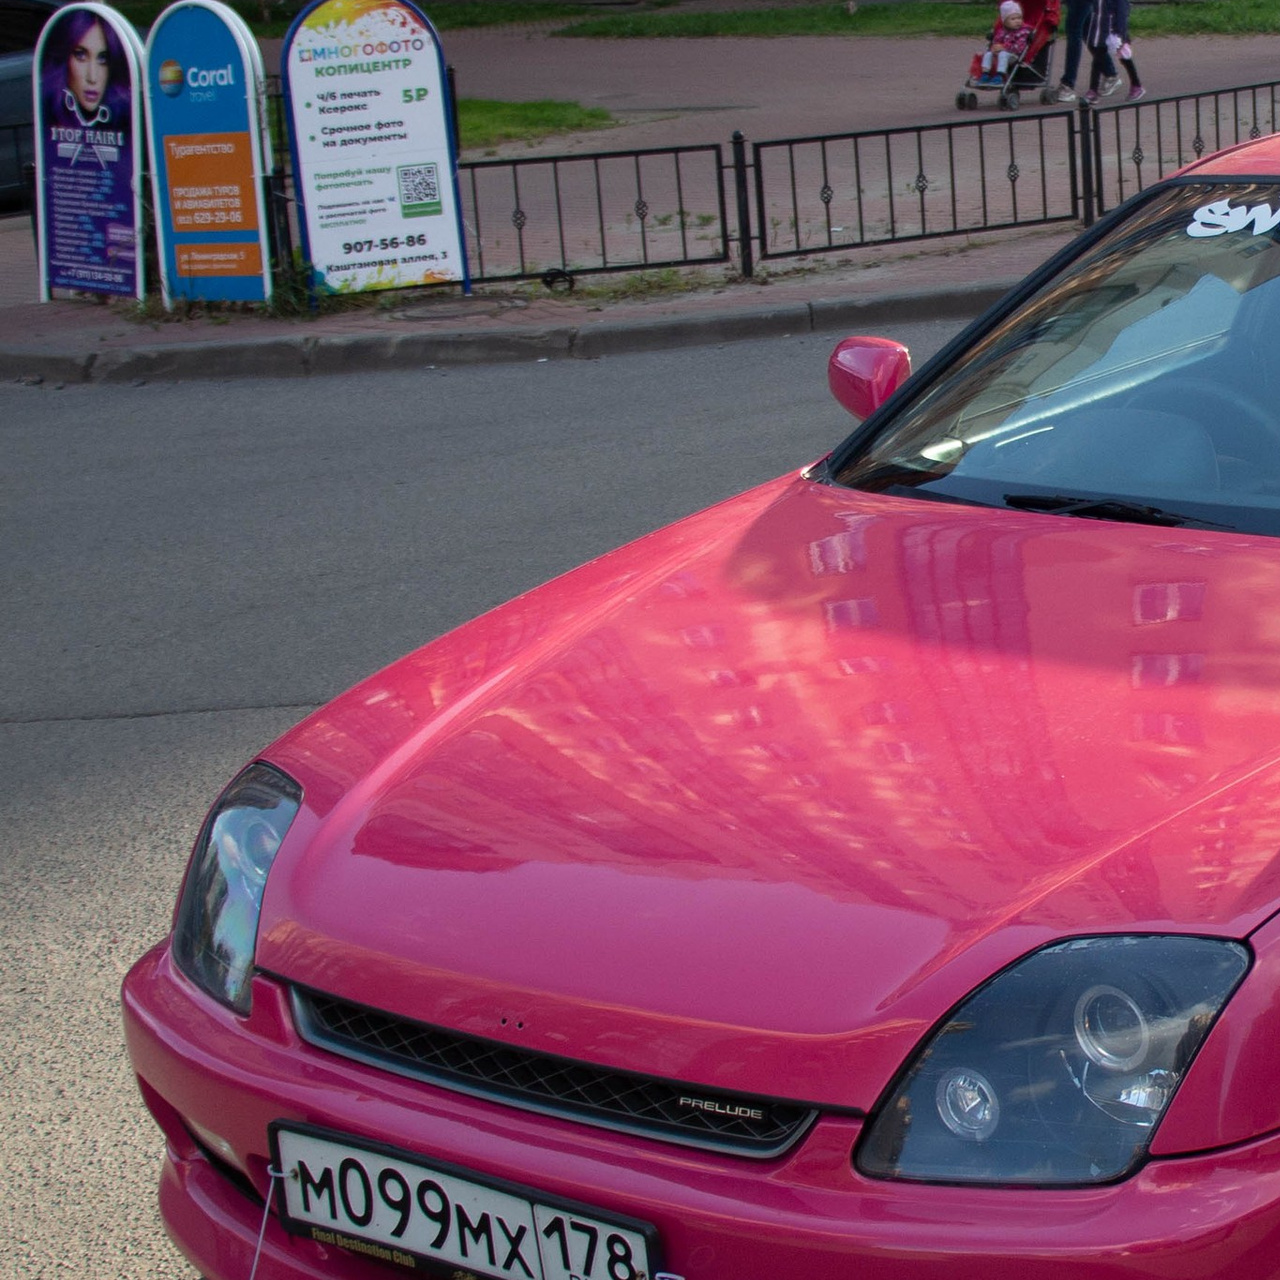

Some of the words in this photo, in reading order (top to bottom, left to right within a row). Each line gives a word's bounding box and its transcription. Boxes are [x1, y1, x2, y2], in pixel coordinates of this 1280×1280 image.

[313, 39, 425, 60] МНОГОФОТО
[186, 64, 234, 88] Coral
[315, 58, 412, 77] КОПИЦЕНТР
[340, 88, 382, 100] печать
[318, 103, 368, 115] Ксерокс
[58, 128, 81, 142] TOP
[85, 130, 117, 145] HAIR
[321, 123, 372, 136] Срочное
[374, 120, 404, 131] фото
[322, 140, 337, 148] на
[340, 133, 408, 146] документы
[314, 168, 363, 180] Попробуй
[365, 166, 392, 175] нашу
[213, 185, 240, 196] ТУРОВ
[342, 233, 427, 255] 907-56-86
[326, 257, 398, 273] Каштановая
[401, 253, 438, 265] аллея,
[440, 251, 448, 260] 3
[680, 1096, 763, 1120] PRELUDE
[311, 1226, 336, 1245] Final
[336, 1234, 393, 1262] Destination
[392, 1249, 417, 1269] Club
